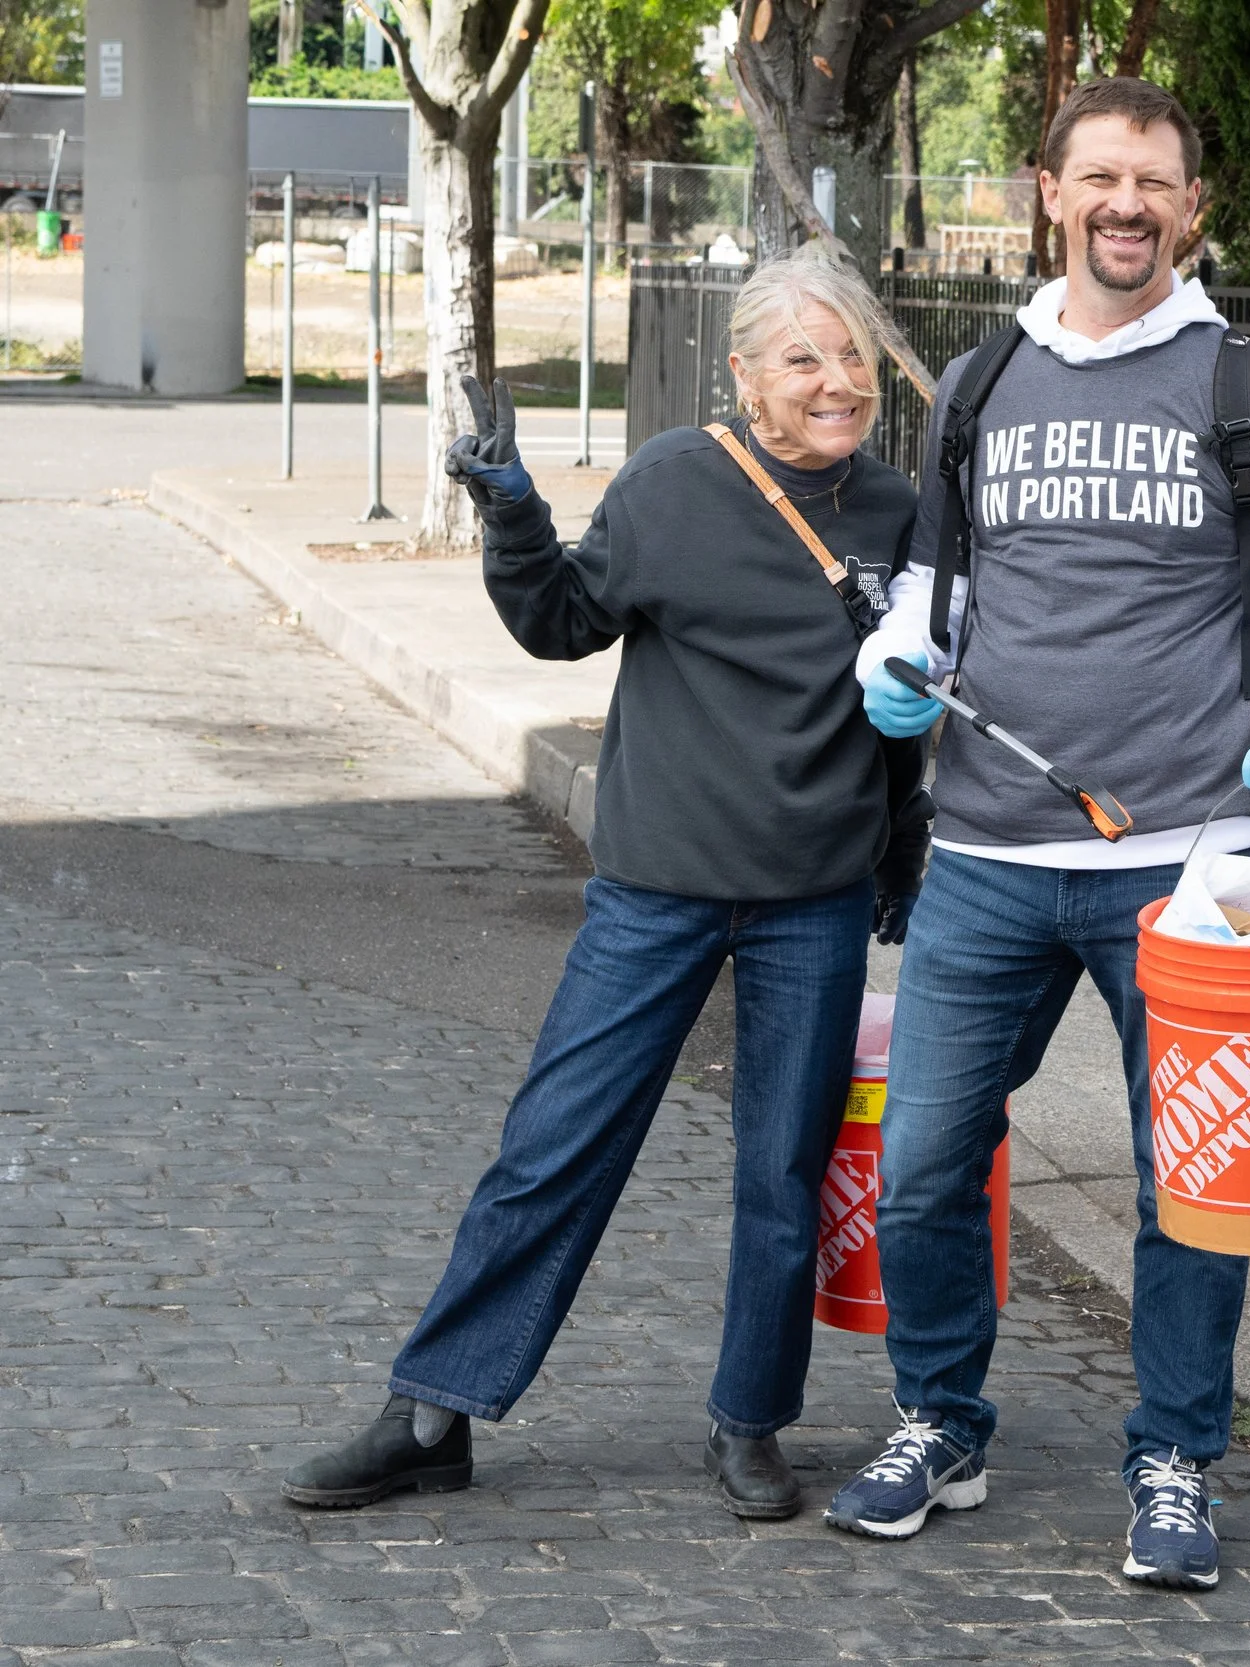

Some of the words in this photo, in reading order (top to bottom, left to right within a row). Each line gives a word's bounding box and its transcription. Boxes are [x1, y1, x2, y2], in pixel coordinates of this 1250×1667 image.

[986, 423, 1037, 477] WE
[1043, 420, 1199, 477] BELIEVE
[982, 481, 1009, 528] IN
[1017, 476, 1204, 528] PORTLAND
[858, 572, 879, 582] UNION
[858, 582, 882, 592] GOSPEL
[864, 591, 885, 601] SSION
[1152, 1042, 1193, 1103] THE
